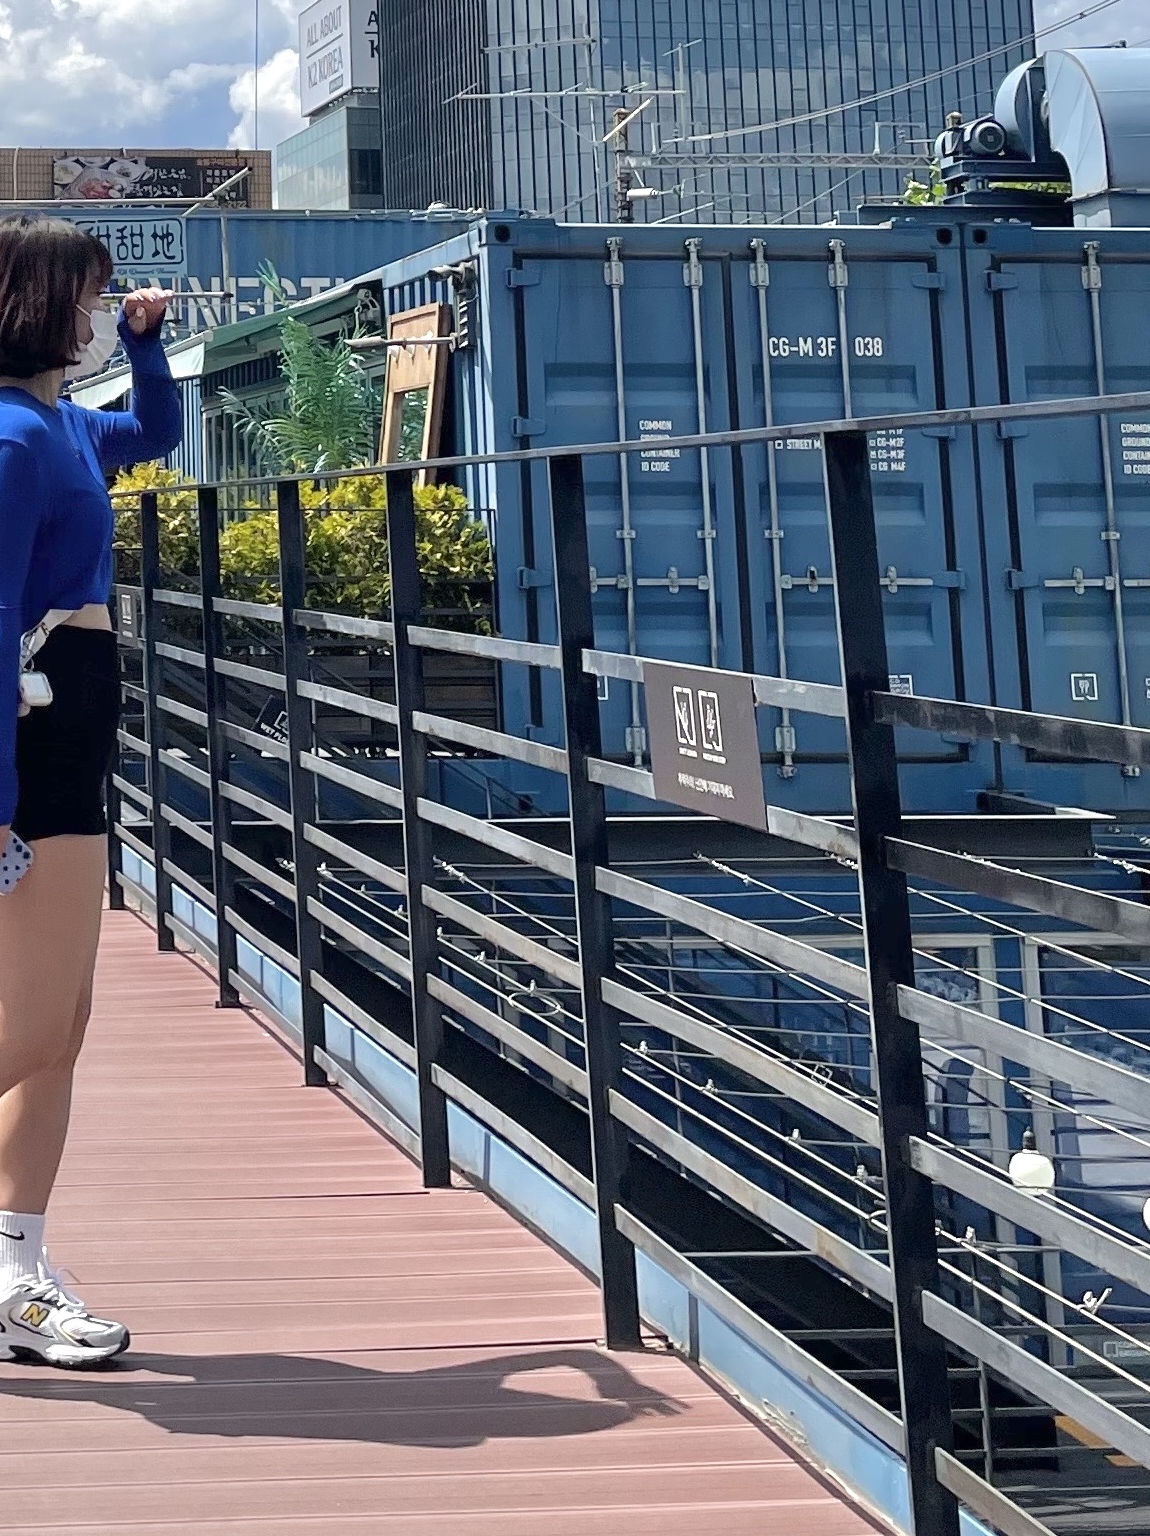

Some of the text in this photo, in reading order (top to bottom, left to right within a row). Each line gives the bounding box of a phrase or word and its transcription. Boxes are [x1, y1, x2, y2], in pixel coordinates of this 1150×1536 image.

[320, 5, 342, 40] ABOUT
[318, 46, 344, 83] KOREA
[769, 336, 883, 357] CG-M 3F 038
[639, 420, 672, 431] COMMON
[786, 439, 812, 449] STREET
[650, 461, 671, 472] CODE
